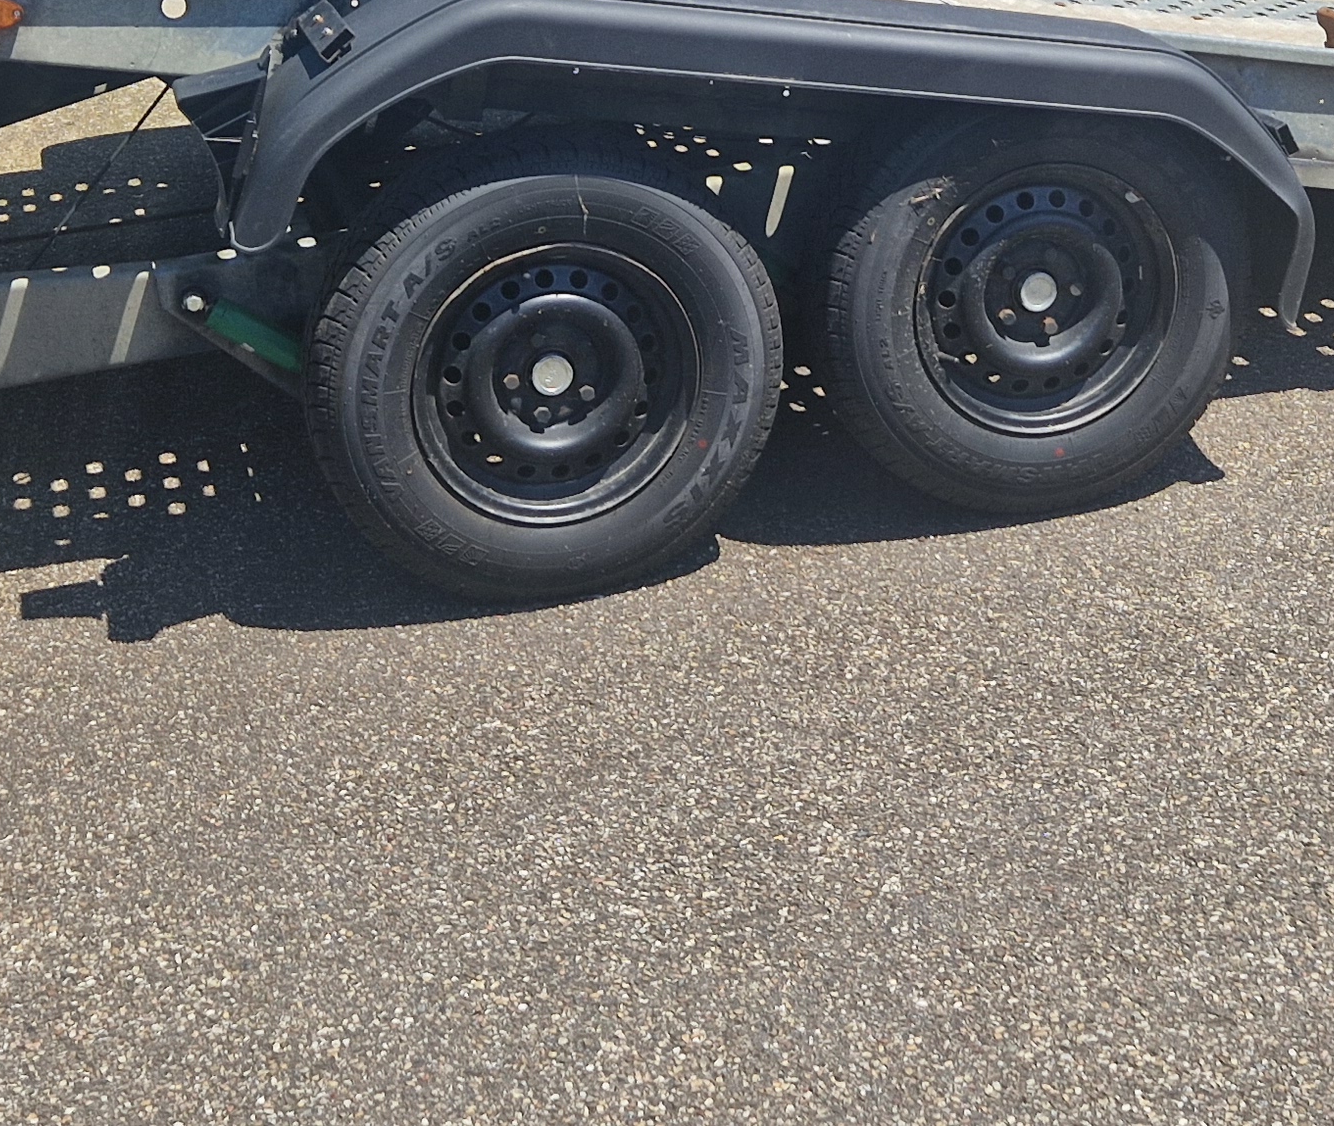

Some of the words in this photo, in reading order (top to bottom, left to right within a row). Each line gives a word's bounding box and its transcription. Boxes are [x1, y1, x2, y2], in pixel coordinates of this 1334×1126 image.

[358, 298, 406, 504] VANSMART
[403, 236, 458, 302] A/S
[663, 327, 749, 532] MAXXIS
